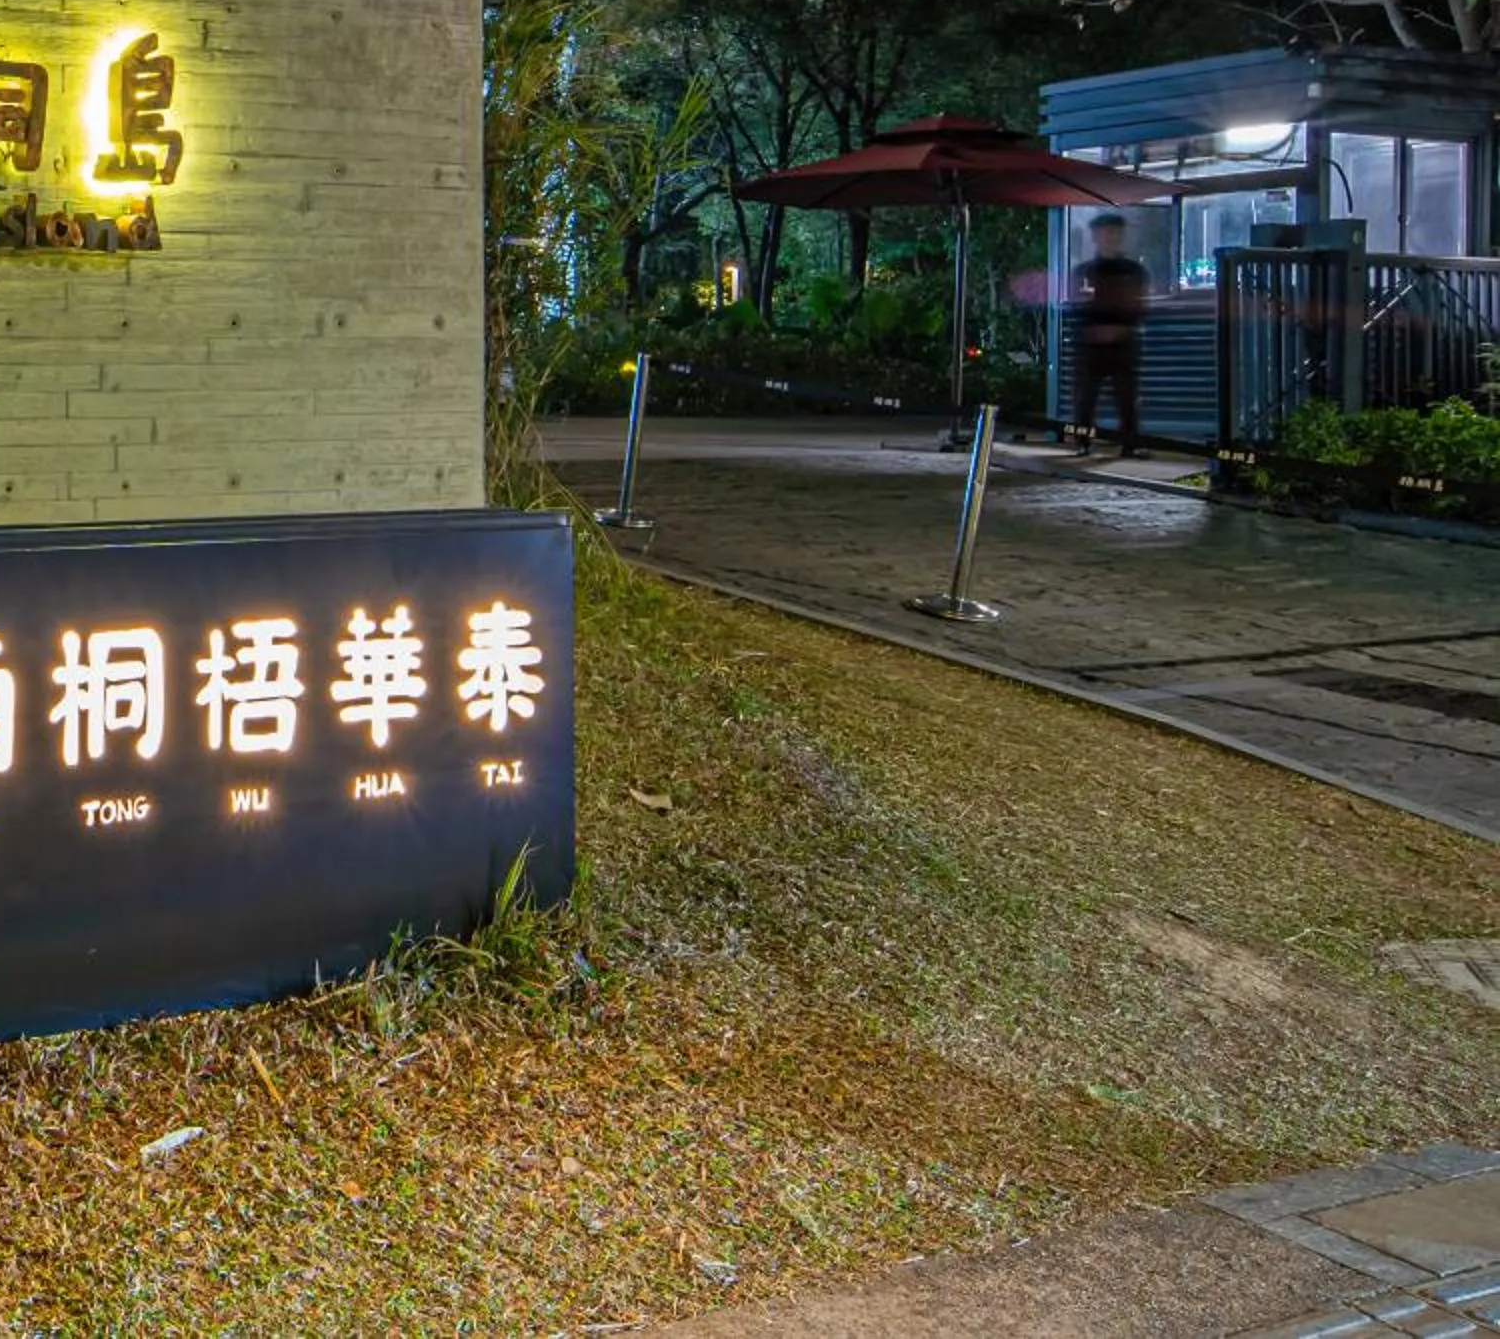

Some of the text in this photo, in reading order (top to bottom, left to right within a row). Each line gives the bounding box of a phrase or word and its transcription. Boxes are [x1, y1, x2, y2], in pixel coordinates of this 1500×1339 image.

[81, 795, 151, 827] TONG
[230, 788, 270, 814] WU
[355, 772, 406, 800] HUA
[480, 760, 524, 788] TAI
